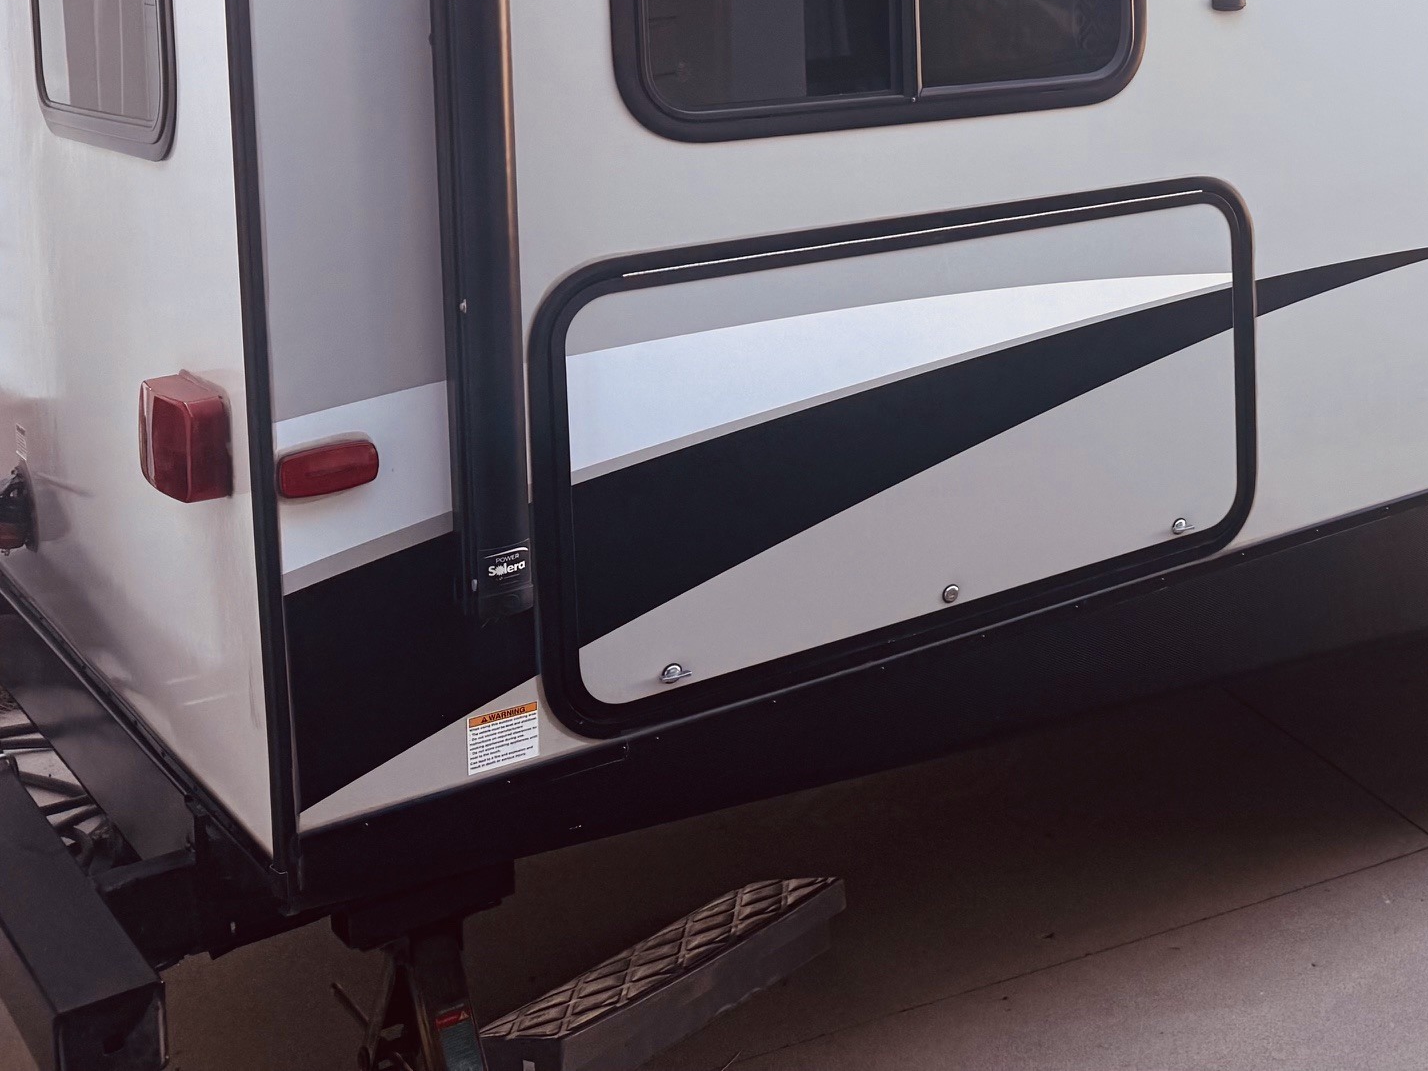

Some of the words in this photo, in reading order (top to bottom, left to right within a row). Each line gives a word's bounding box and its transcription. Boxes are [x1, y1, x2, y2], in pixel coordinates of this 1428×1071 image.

[495, 553, 520, 563] POWER
[488, 560, 526, 577] Solera
[489, 706, 526, 720] WARNING
